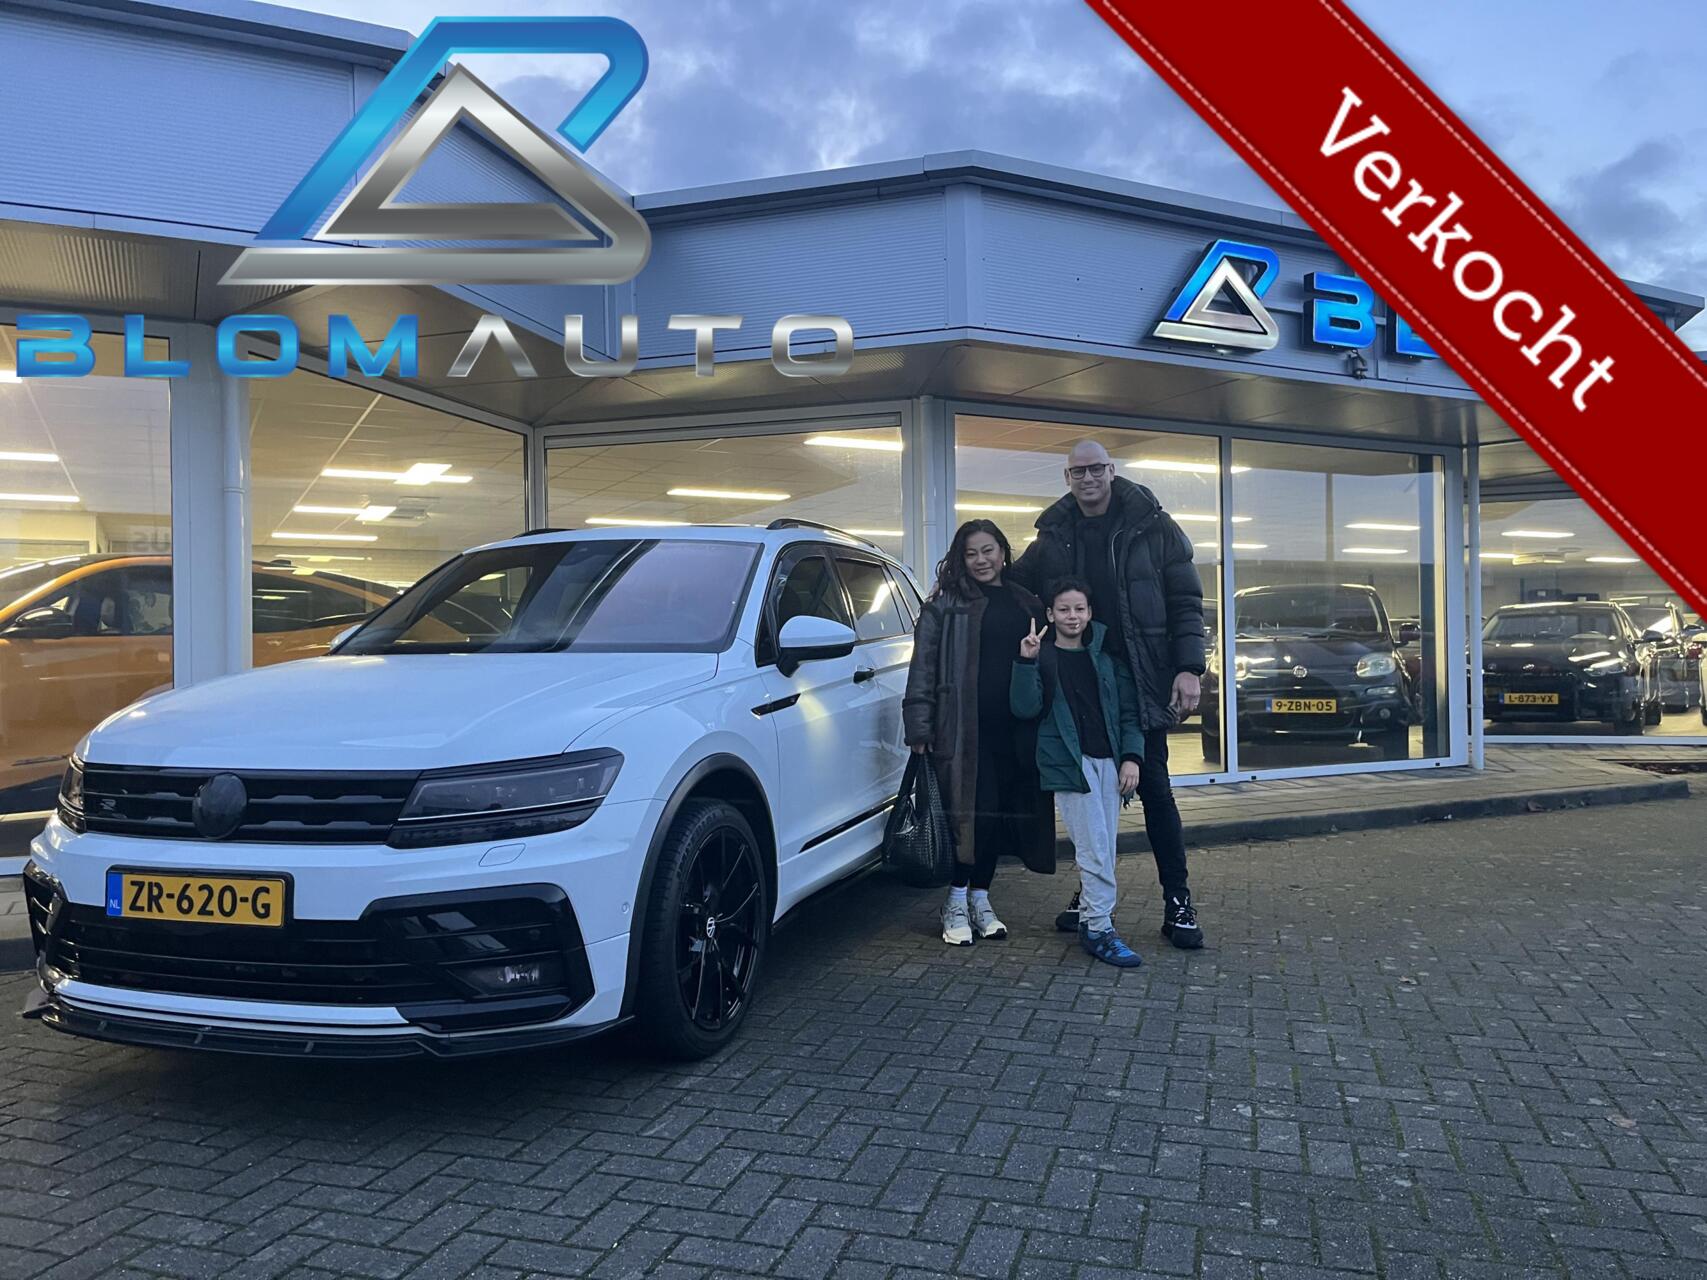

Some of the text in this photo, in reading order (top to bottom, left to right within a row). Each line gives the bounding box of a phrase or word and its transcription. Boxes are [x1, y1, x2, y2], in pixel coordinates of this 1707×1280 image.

[1275, 700, 1333, 712] 9-ZBN-05
[109, 899, 120, 909] NL
[129, 880, 271, 919] ZR-620-G
